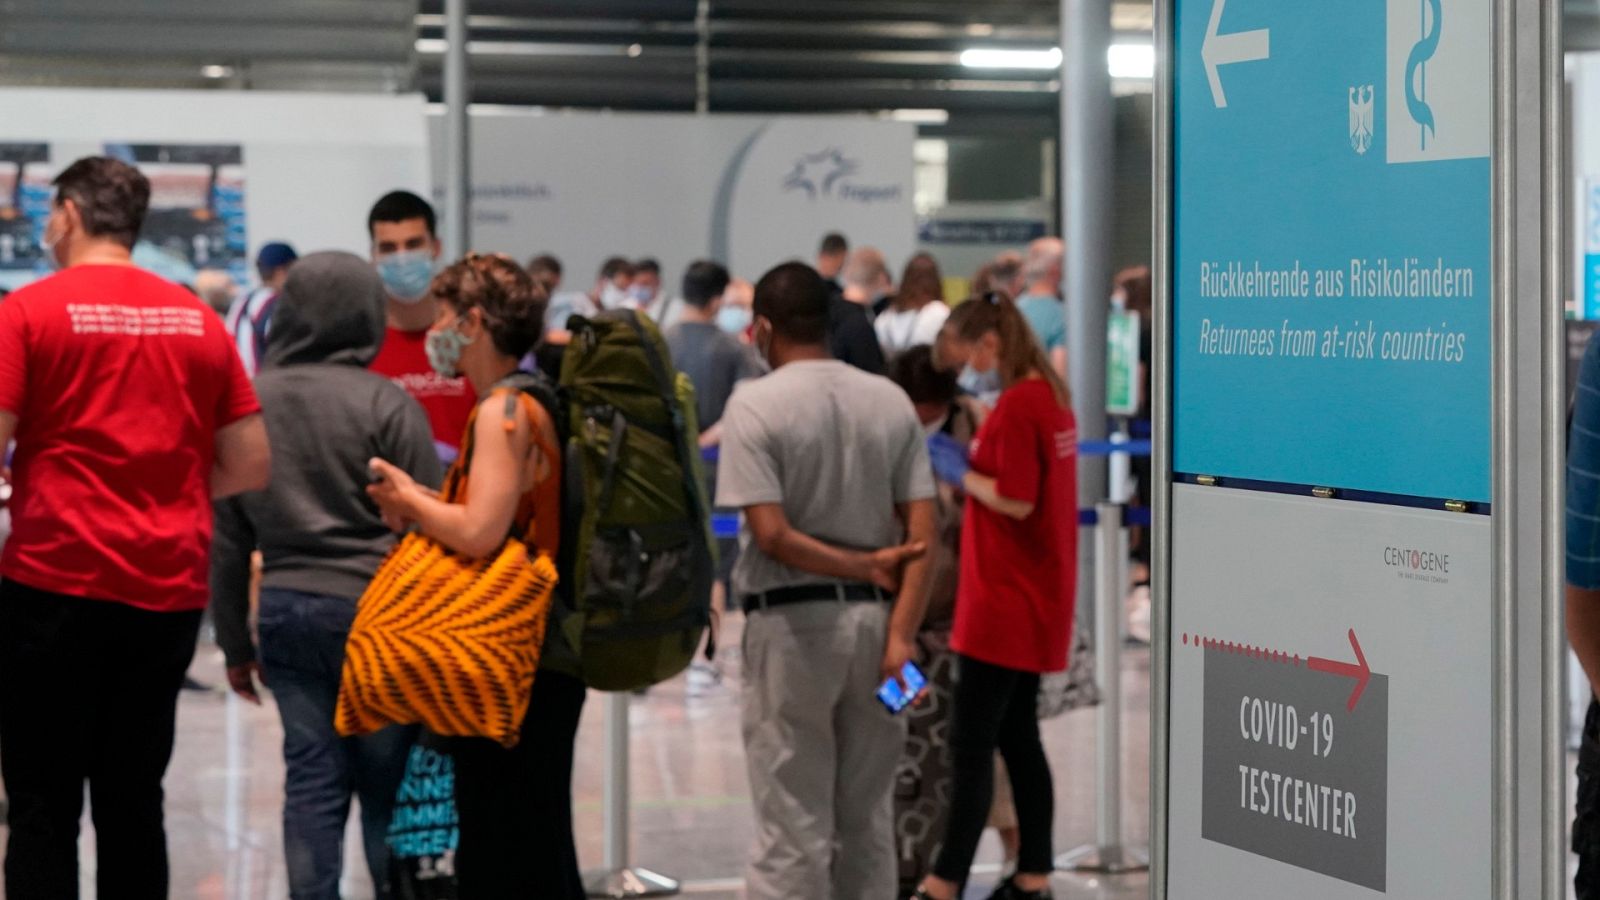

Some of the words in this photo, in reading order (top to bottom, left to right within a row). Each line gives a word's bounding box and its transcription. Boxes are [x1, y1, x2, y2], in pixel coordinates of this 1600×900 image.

[1200, 260, 1309, 298] Rückkehrende
[1315, 269, 1344, 298] aus
[1350, 256, 1473, 298] Risikoländern
[1199, 318, 1275, 356] Returnees
[1280, 319, 1317, 357] from
[1321, 320, 1377, 359] at-risk
[1381, 322, 1465, 362] countries
[1384, 546, 1449, 573] CENTOGENE
[1240, 695, 1334, 758] COVID-19
[1239, 764, 1357, 839] TESTCENTER
